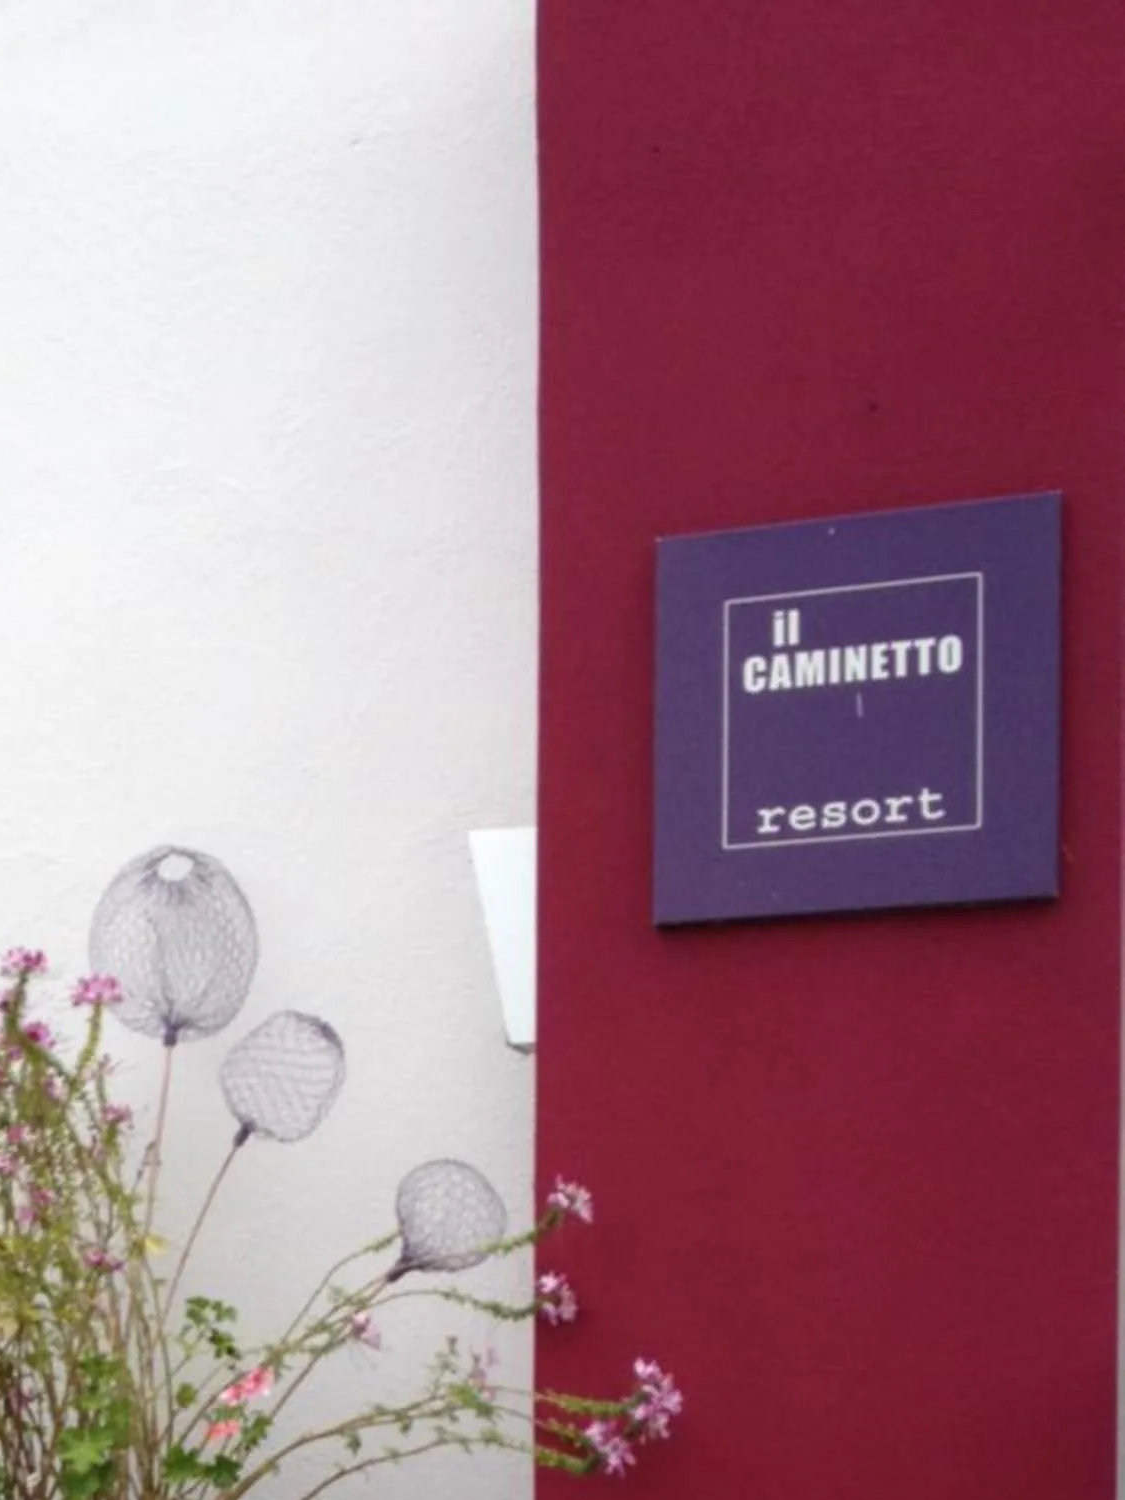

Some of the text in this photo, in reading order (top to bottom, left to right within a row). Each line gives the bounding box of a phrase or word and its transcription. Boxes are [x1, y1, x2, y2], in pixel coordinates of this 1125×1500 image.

[773, 608, 800, 648] il
[742, 635, 963, 694] CAMINETTO
[757, 787, 945, 834] resort
